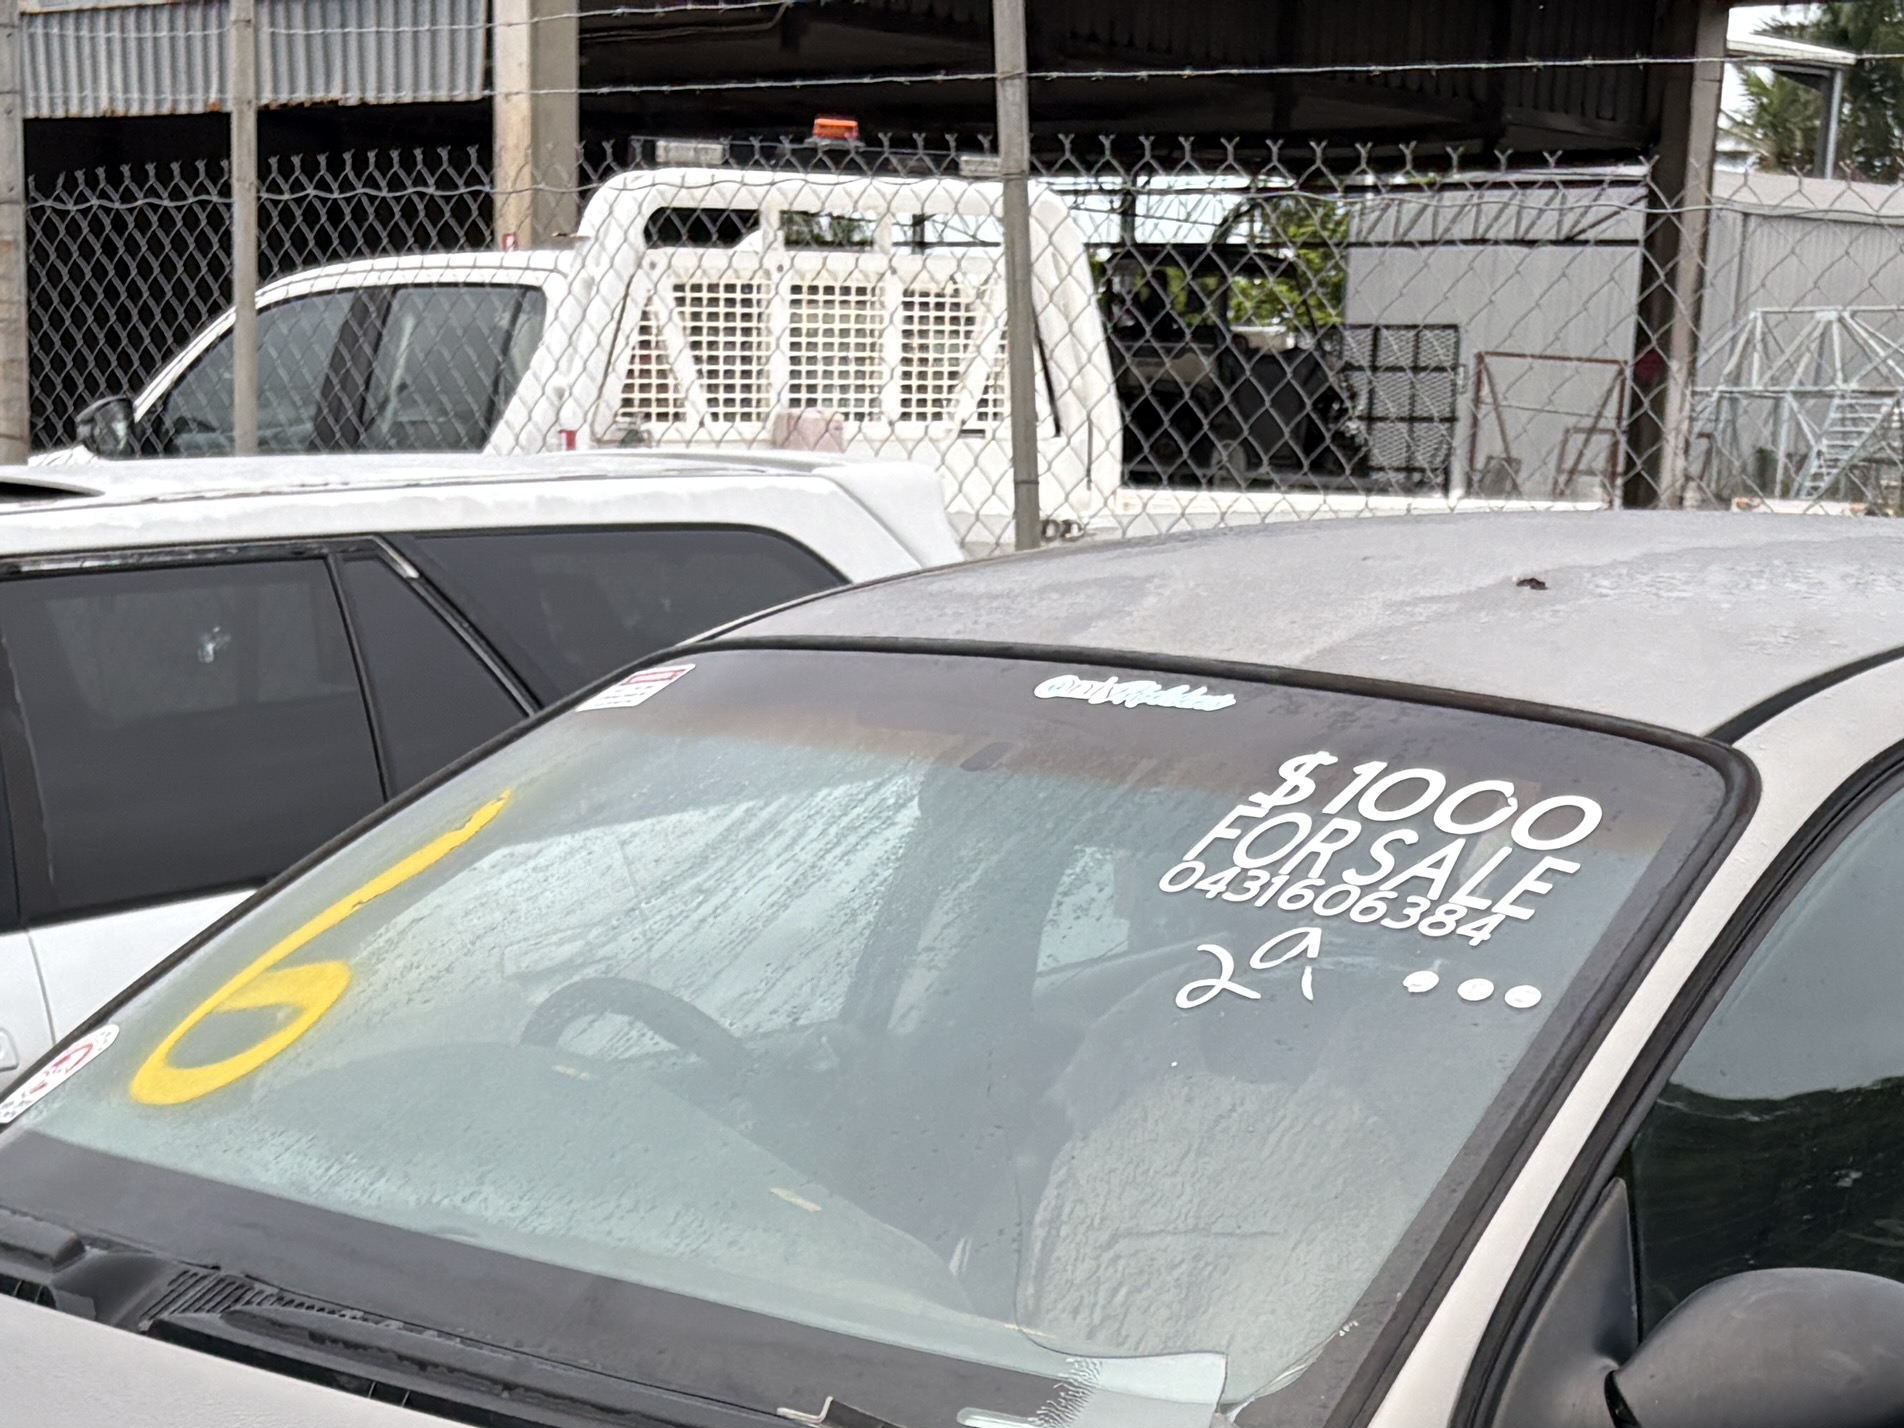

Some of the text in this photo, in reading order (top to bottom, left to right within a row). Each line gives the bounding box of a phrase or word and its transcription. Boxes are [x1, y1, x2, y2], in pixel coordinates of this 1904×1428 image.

[1248, 751, 1603, 851] $1000
[1158, 860, 1507, 947] 0431606384
[1183, 804, 1581, 921] FOR SALE
